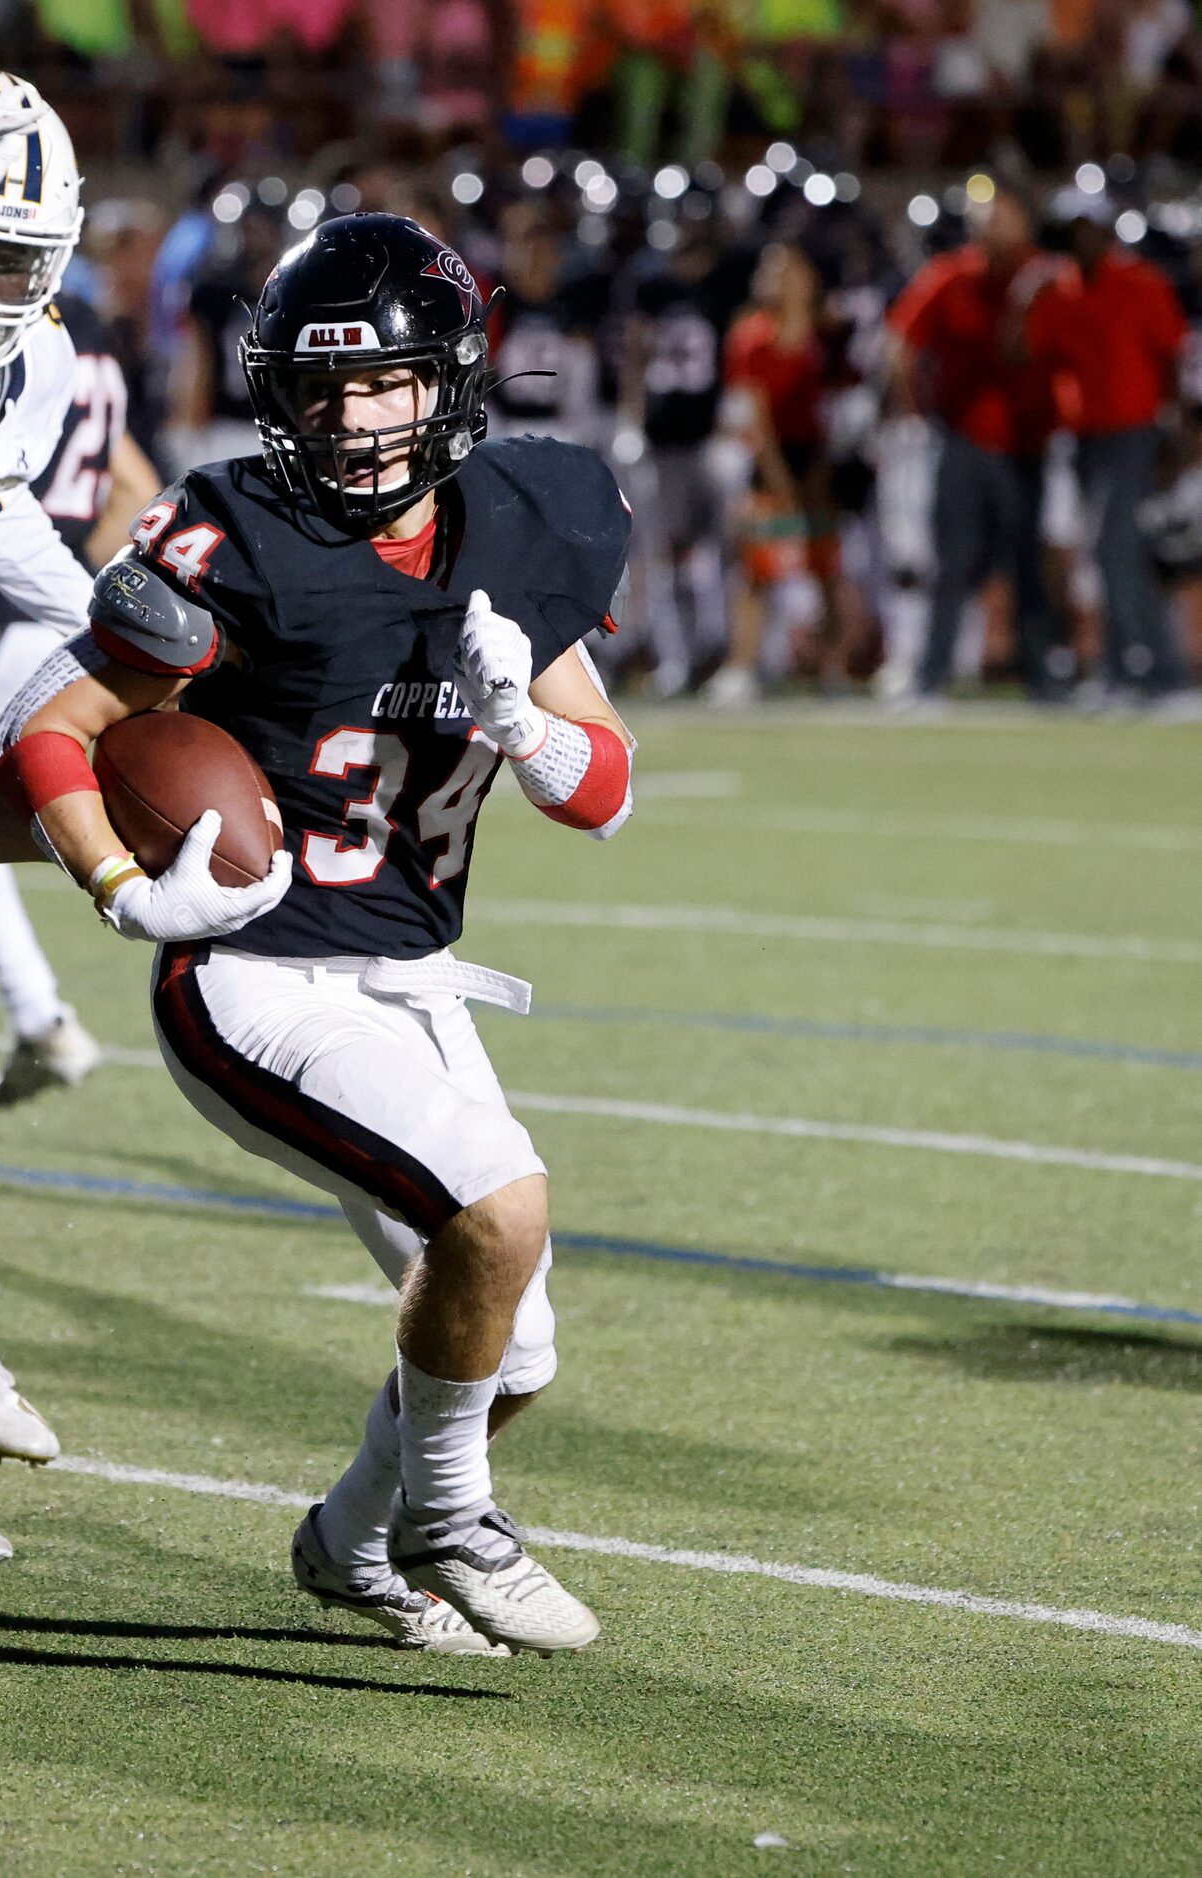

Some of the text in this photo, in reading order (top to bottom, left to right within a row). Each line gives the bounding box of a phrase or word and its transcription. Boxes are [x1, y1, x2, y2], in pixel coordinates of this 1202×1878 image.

[309, 327, 362, 347] ALL IN
[300, 725, 505, 890] 34
